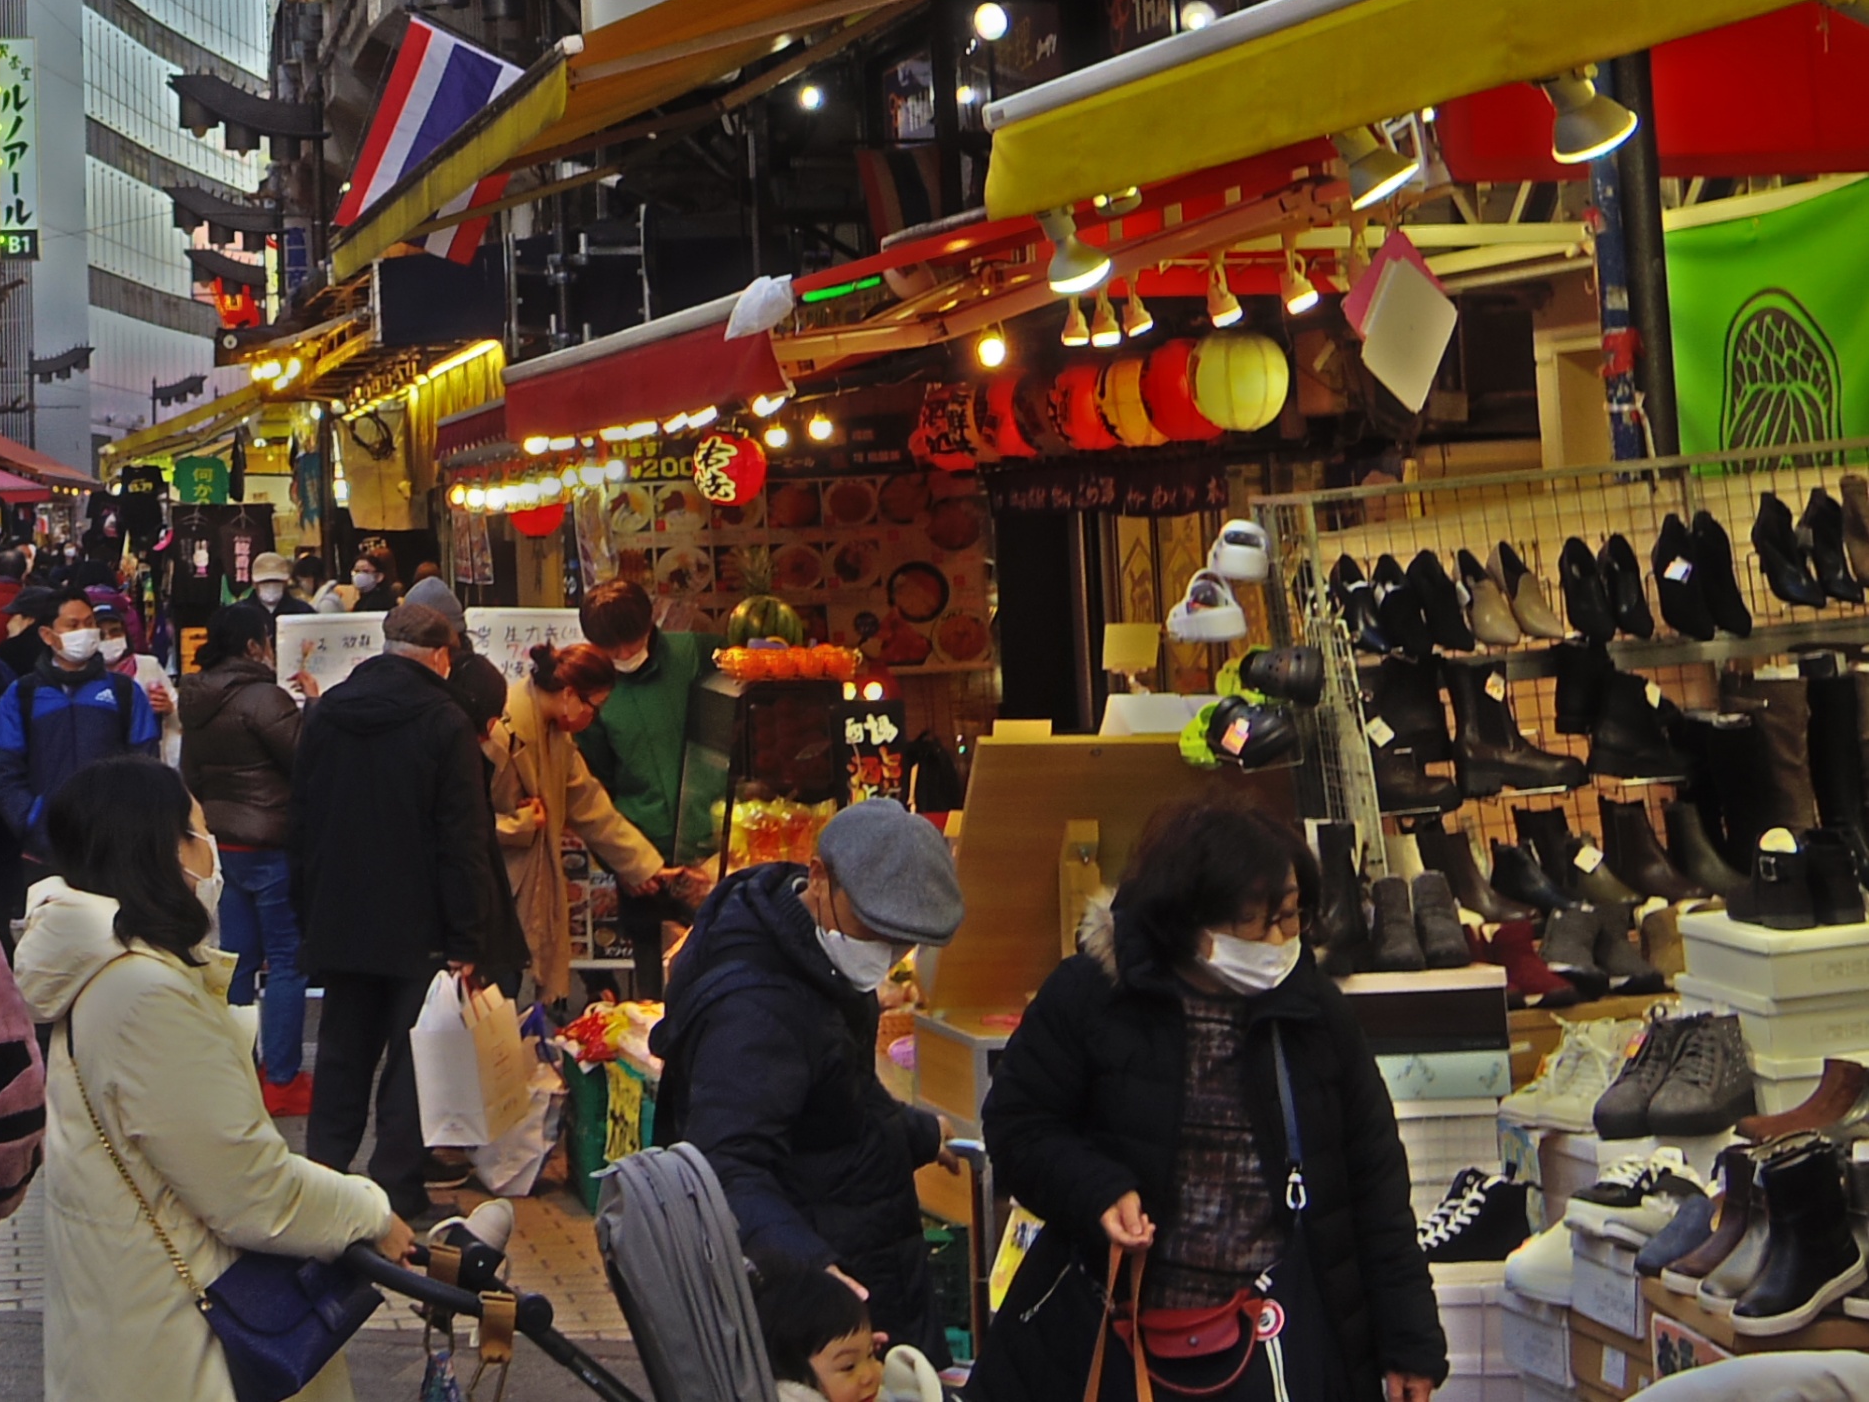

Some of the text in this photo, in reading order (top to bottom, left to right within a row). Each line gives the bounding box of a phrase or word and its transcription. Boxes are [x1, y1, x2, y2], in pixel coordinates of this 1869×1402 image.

[1, 83, 33, 227] ルノアール
[7, 235, 31, 254] B1
